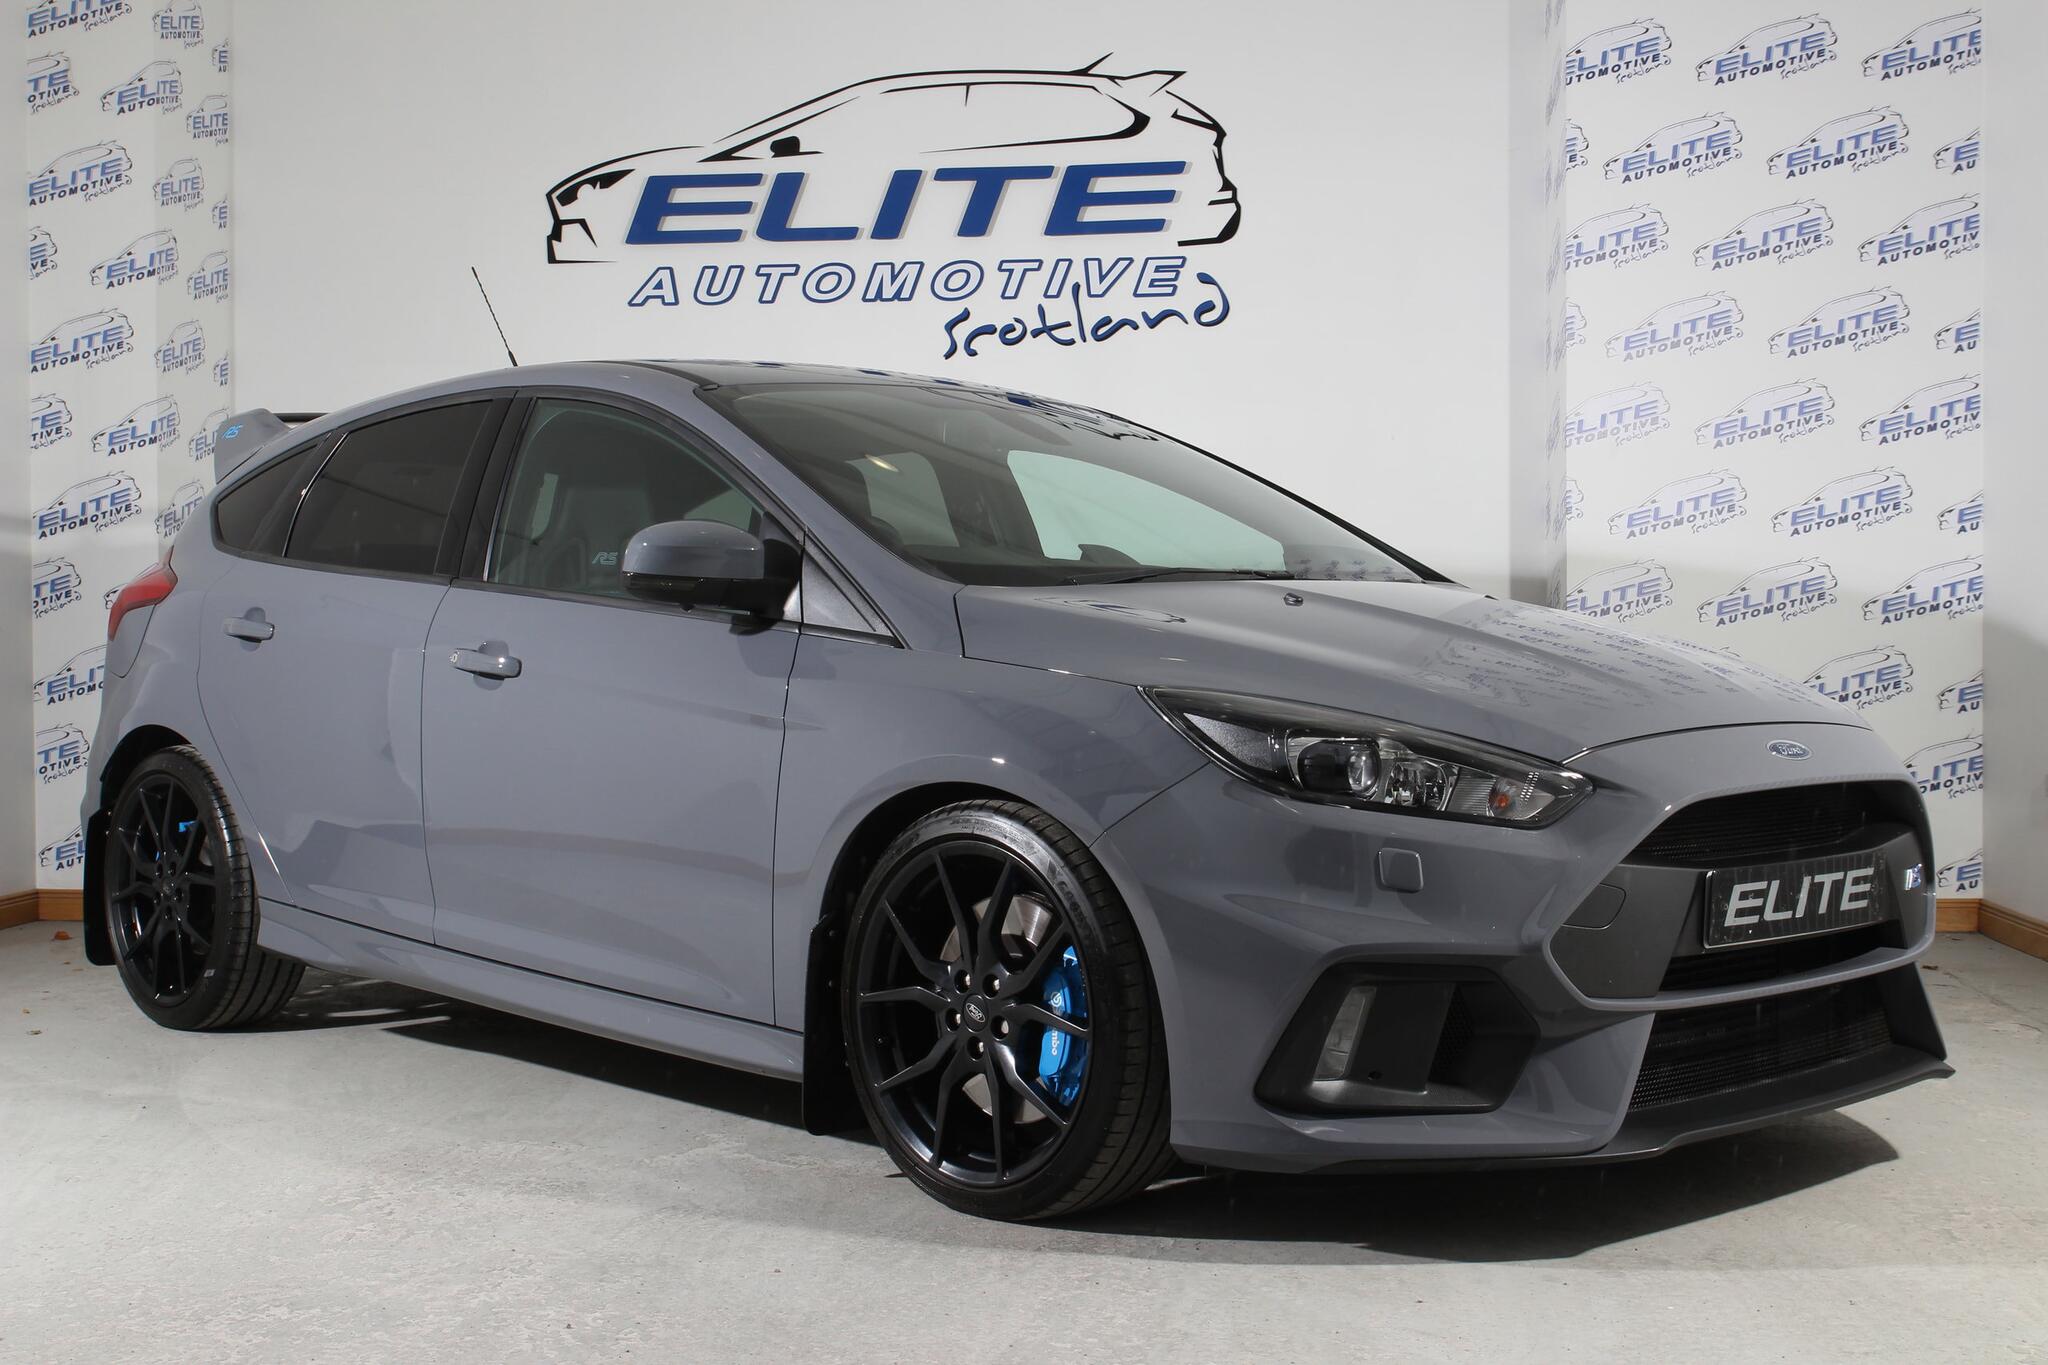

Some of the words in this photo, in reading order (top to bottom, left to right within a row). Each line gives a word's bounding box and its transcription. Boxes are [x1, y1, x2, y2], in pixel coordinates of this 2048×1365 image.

[28, 2, 123, 38] AUTOMOTIVE
[160, 15, 200, 30] ELITE
[160, 31, 201, 39] AUTOMOTIVE
[1714, 48, 1825, 85] AUTOMOTIVE
[1715, 31, 1825, 75] ELITE
[1881, 29, 1981, 70] ELITE
[117, 80, 178, 106] ELITE
[117, 97, 178, 115] AUTOMOTIVE
[193, 113, 228, 130] ELITE
[1622, 130, 1731, 173] ELITE
[1786, 124, 1898, 168] ELITE
[1786, 141, 1898, 179] AUTOMOTIVE
[29, 157, 123, 197] ELITE
[1622, 147, 1731, 184] AUTOMOTIVE
[29, 174, 123, 207] AUTOMOTIVE
[161, 176, 200, 197] ELITE
[161, 191, 201, 207] AUTOMOTIVE
[624, 160, 1193, 245] ELITE
[1712, 217, 1822, 260] ELITE
[1712, 234, 1822, 270] AUTOMOTIVE
[1878, 213, 1980, 255] ELITE
[106, 248, 175, 279] ELITE
[106, 263, 176, 289] AUTOMOTIVE
[193, 268, 228, 290] ELITE
[628, 255, 1187, 307] AUTOMOTIVE
[943, 272, 1230, 359] Scotland
[1624, 309, 1733, 351] ELITE
[1788, 304, 1899, 348] ELITE
[31, 325, 124, 364] ELITE
[31, 341, 124, 373] AUTOMOTIVE
[163, 337, 201, 364] ELITE
[1623, 325, 1733, 362] AUTOMOTIVE
[1787, 321, 1898, 358] AUTOMOTIVE
[163, 352, 202, 373] AUTOMOTIVE
[108, 411, 176, 447] ELITE
[1713, 413, 1823, 449] AUTOMOTIVE
[1714, 395, 1824, 439] ELITE
[1879, 394, 1981, 435] ELITE
[108, 429, 177, 456] AUTOMOTIVE
[38, 488, 131, 530] ELITE
[39, 504, 132, 539] AUTOMOTIVE
[1626, 503, 1736, 539] AUTOMOTIVE
[1627, 486, 1737, 528] ELITE
[1790, 501, 1901, 537] AUTOMOTIVE
[1791, 484, 1901, 526] ELITE
[1716, 575, 1825, 617] ELITE
[1716, 592, 1825, 627] AUTOMOTIVE
[1881, 575, 1983, 615] ELITE
[1810, 663, 1901, 696] LITE
[1830, 680, 1902, 703] MOTIVE
[1724, 867, 1874, 927] ELITE
